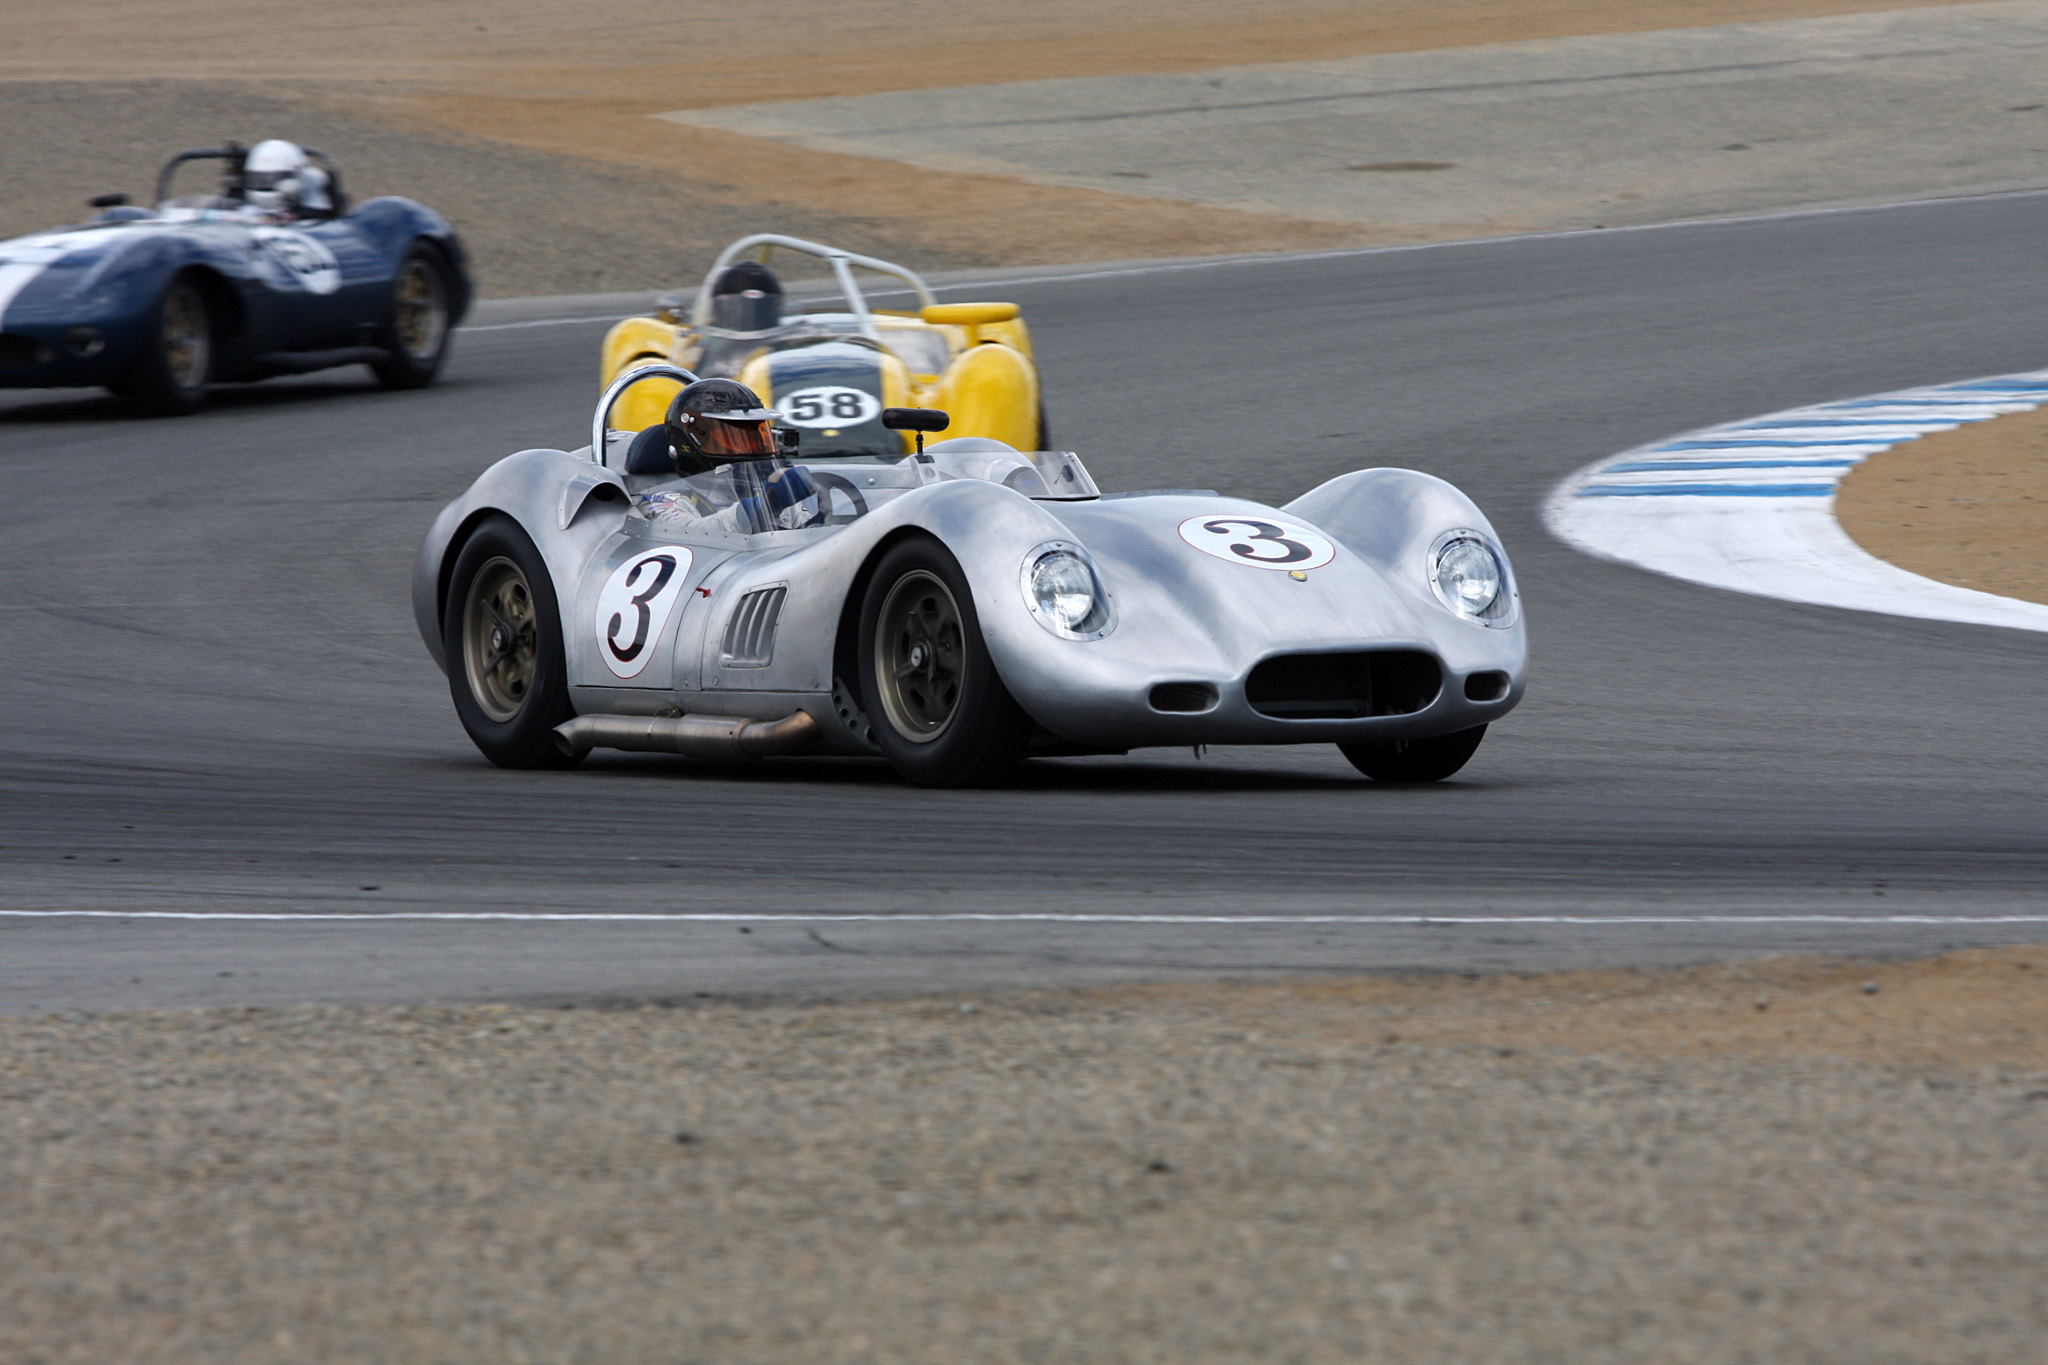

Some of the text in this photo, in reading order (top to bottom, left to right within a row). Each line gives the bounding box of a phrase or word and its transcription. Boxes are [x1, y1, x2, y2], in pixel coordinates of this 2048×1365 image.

[791, 393, 863, 421] 58
[1203, 519, 1312, 563] 3
[607, 554, 677, 663] 3
